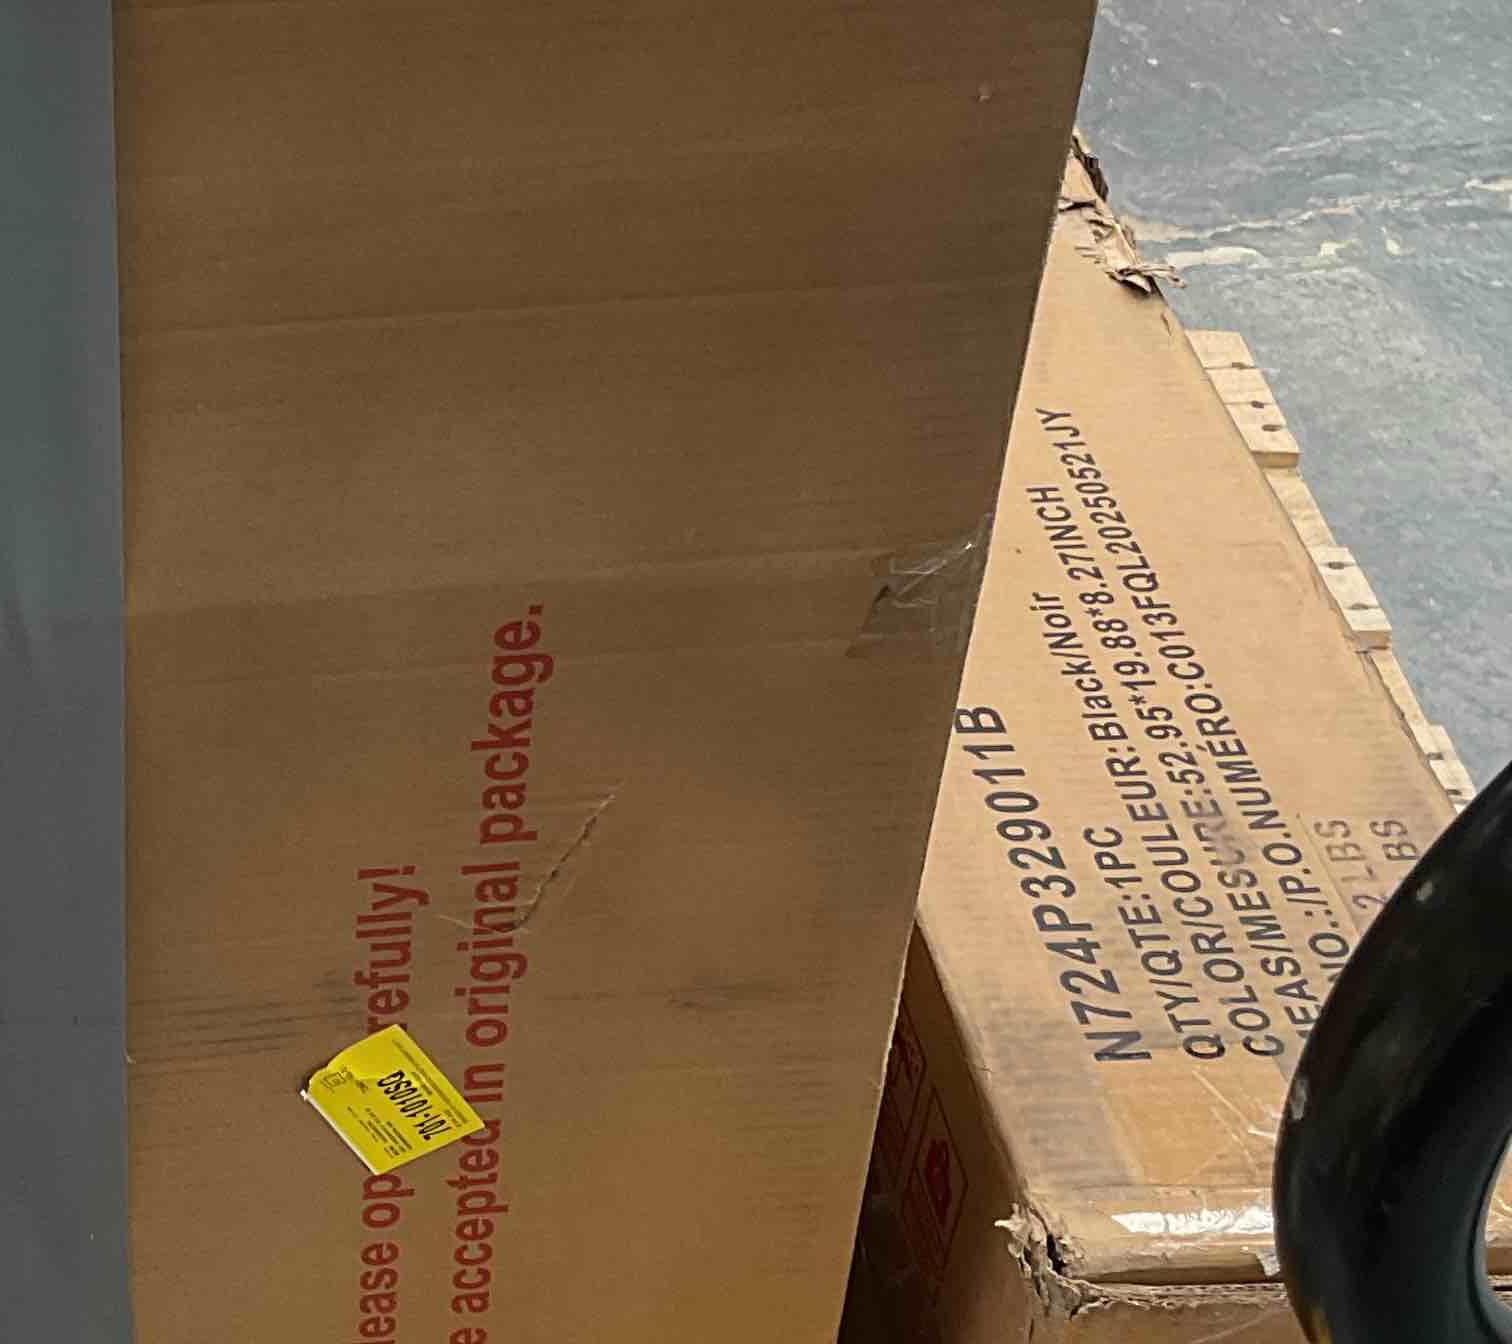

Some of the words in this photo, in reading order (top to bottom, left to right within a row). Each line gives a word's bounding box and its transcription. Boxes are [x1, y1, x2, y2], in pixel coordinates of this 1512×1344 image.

[470, 604, 554, 846] package.
[1029, 591, 1286, 1058] COLOR/COULEUR:Black/Noir
[1369, 819, 1421, 862] BS
[454, 860, 528, 1049] original
[955, 705, 1152, 1062] N724P329011B
[1084, 824, 1226, 1059] QTY/QTE:1PC
